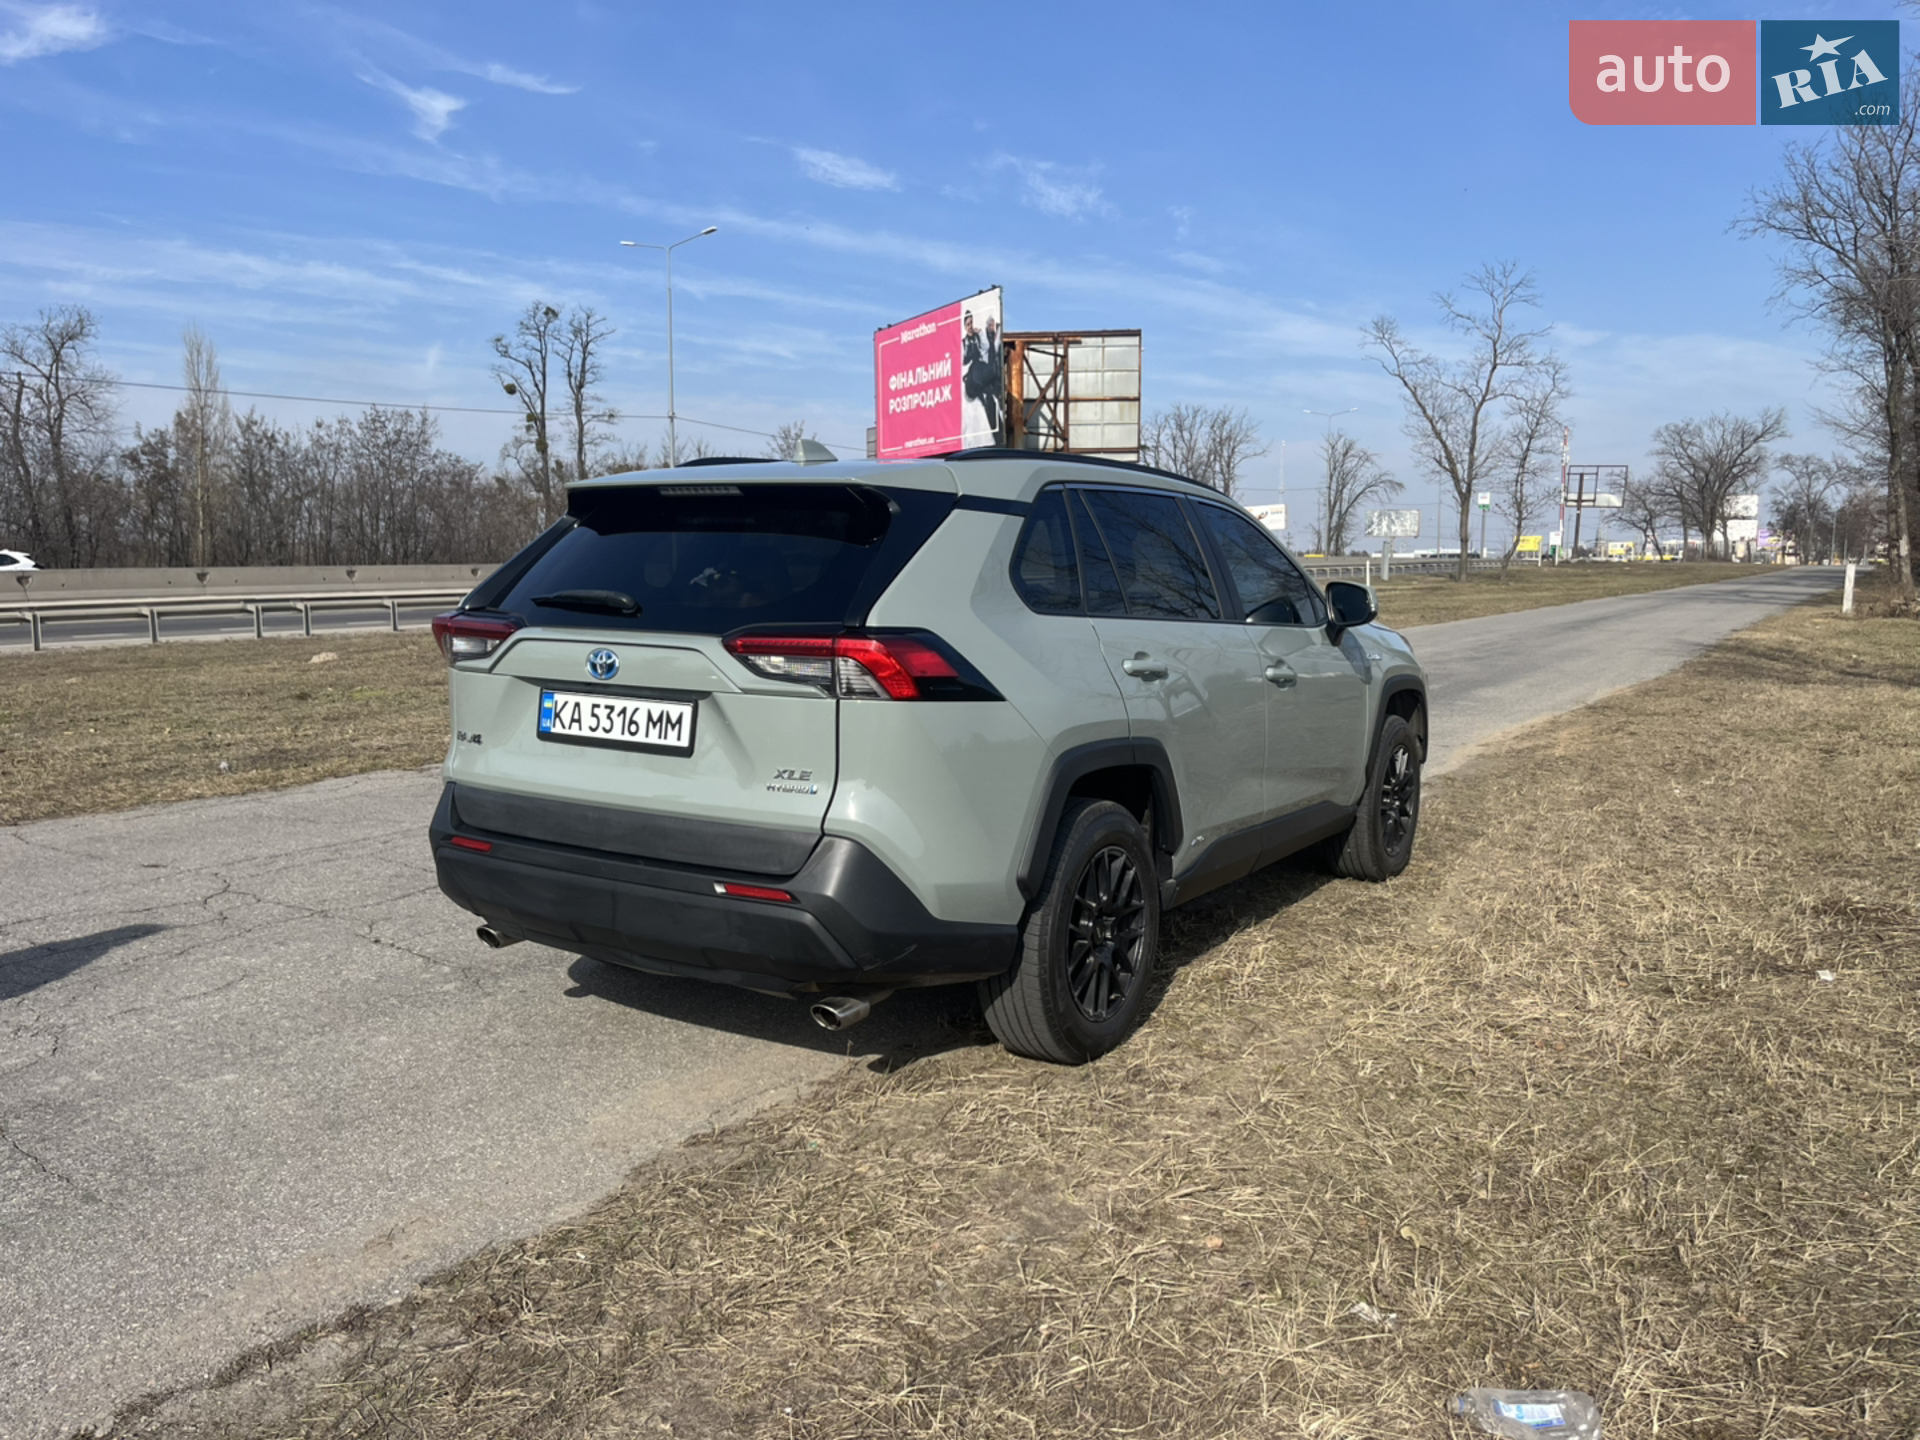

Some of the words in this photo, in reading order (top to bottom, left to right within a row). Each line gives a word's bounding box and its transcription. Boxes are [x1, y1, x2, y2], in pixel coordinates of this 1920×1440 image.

[900, 321, 937, 344] Marathon
[888, 352, 952, 391] ФІНАЛЬНИЙ
[888, 384, 953, 415] РОЗПРОДАЖ
[552, 699, 582, 732] KA
[588, 703, 640, 737] 5316
[645, 708, 684, 742] MM
[772, 769, 813, 781] XLE
